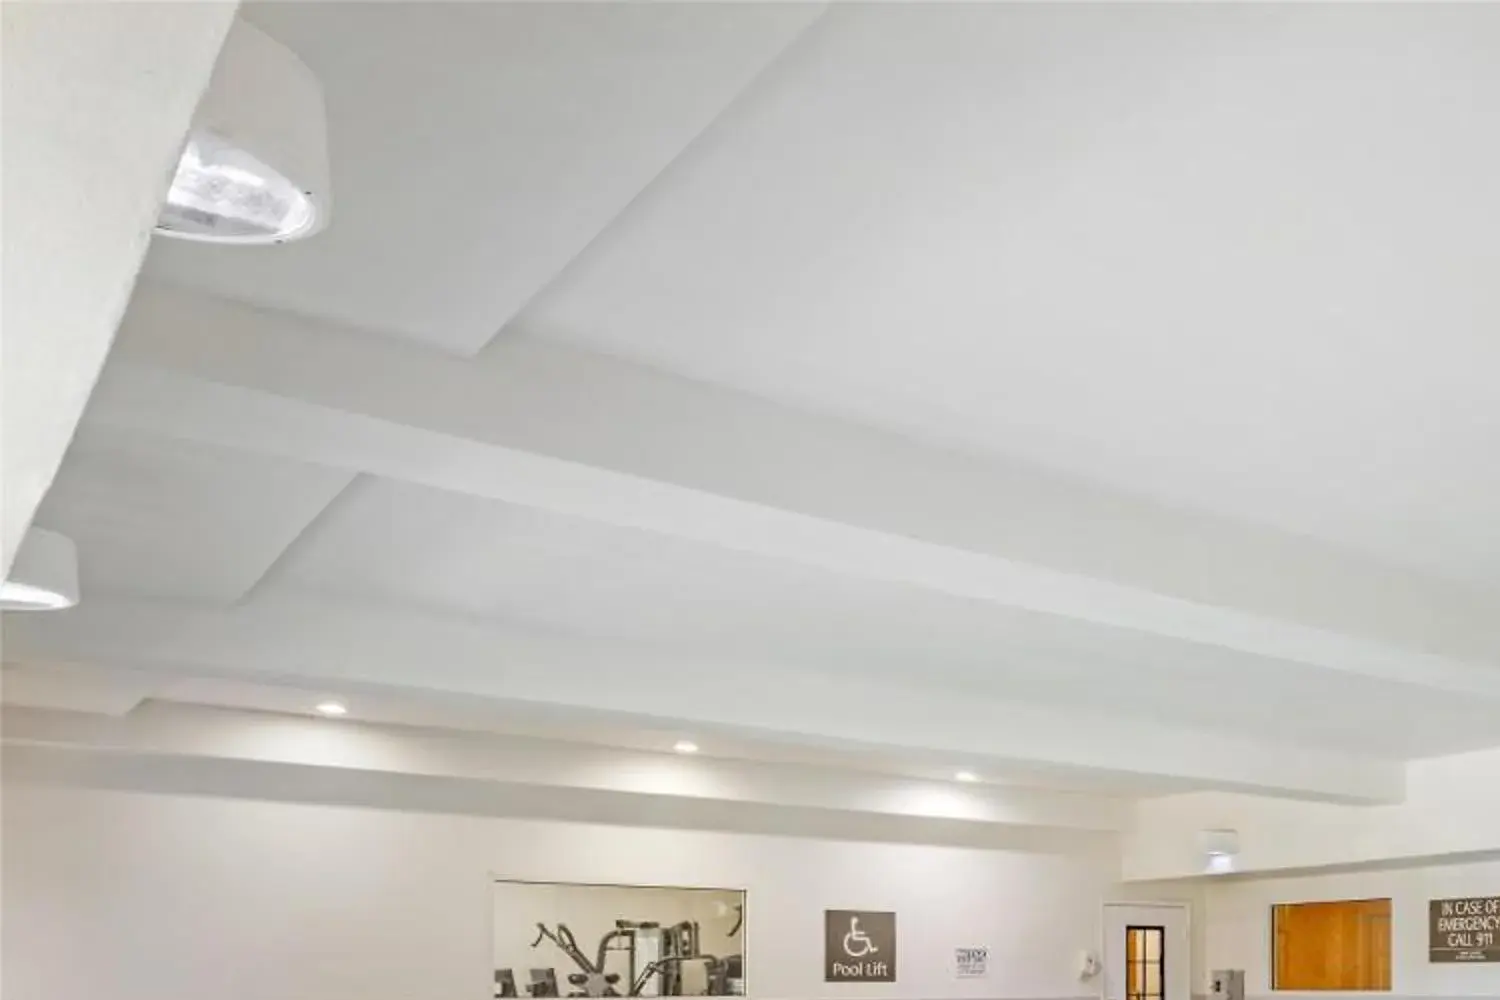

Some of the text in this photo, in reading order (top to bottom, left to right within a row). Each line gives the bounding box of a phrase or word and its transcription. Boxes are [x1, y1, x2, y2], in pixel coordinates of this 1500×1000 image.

[1441, 900, 1500, 916] IN CASE OF
[1447, 933, 1493, 947] CALL 911
[833, 961, 888, 977] Pool Lift
